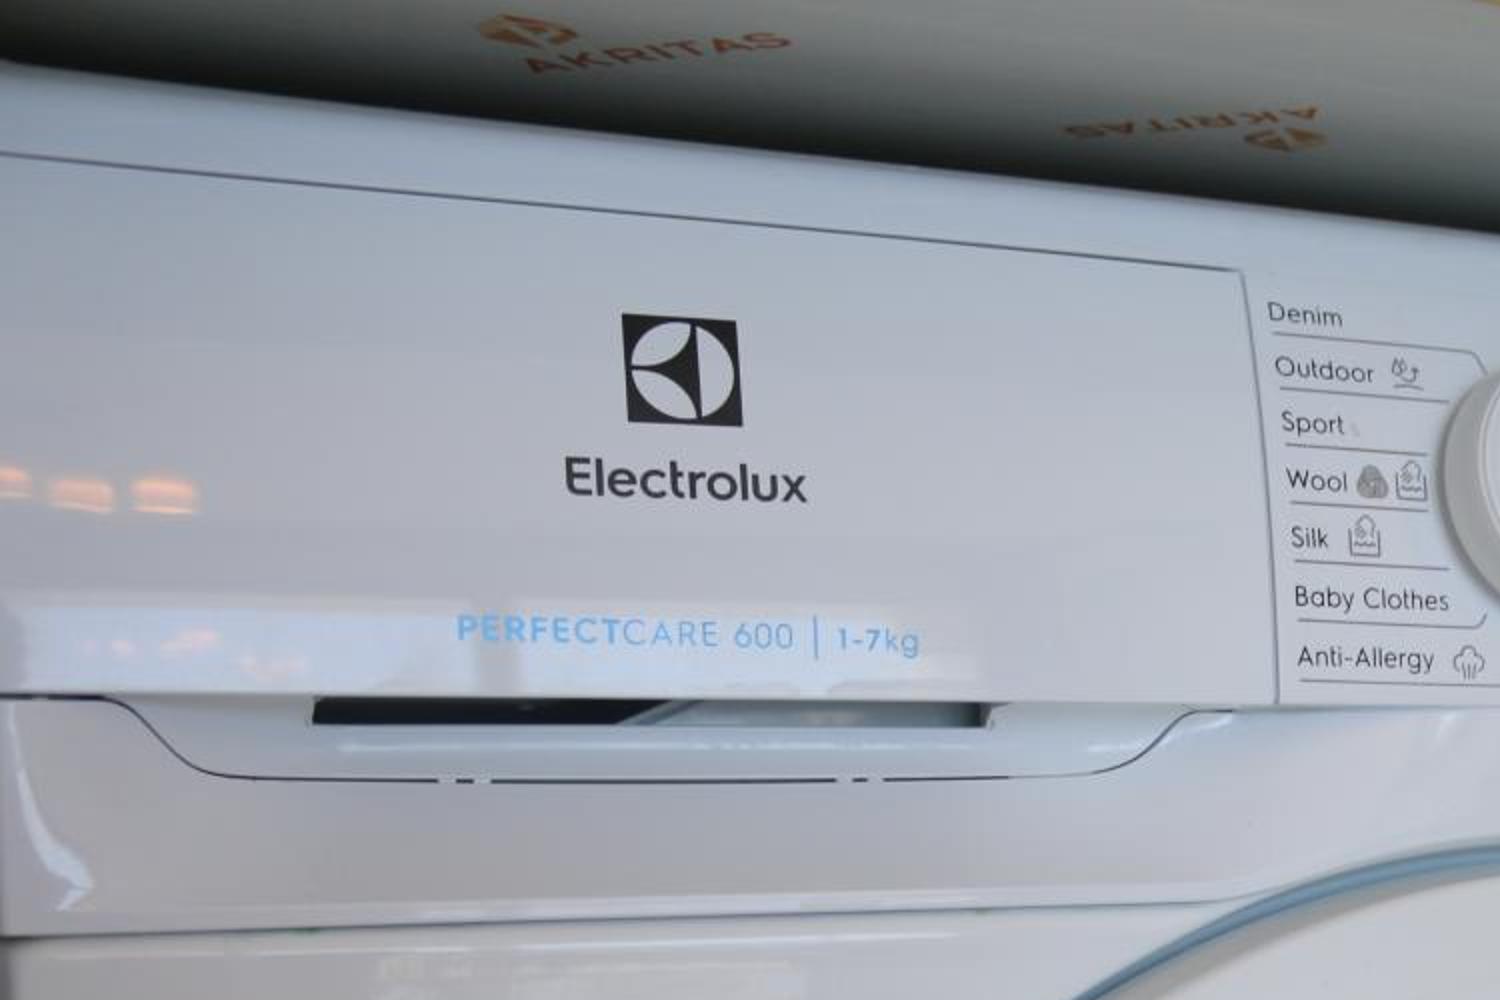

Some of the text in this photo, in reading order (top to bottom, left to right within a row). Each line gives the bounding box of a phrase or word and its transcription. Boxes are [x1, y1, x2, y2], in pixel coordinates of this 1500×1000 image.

[526, 32, 792, 74] AKRITAS
[1267, 301, 1344, 328] Denim
[1274, 355, 1374, 384] Outdoor
[1280, 410, 1346, 440] Sport
[564, 455, 808, 504] Electrolux
[1285, 467, 1349, 493] Wool
[1290, 525, 1330, 549] Silk
[1294, 585, 1450, 614] Baby Clothes
[456, 613, 921, 660] PERFECTCARE 600 1-7kg
[1297, 645, 1435, 675] Anti-Allergy
